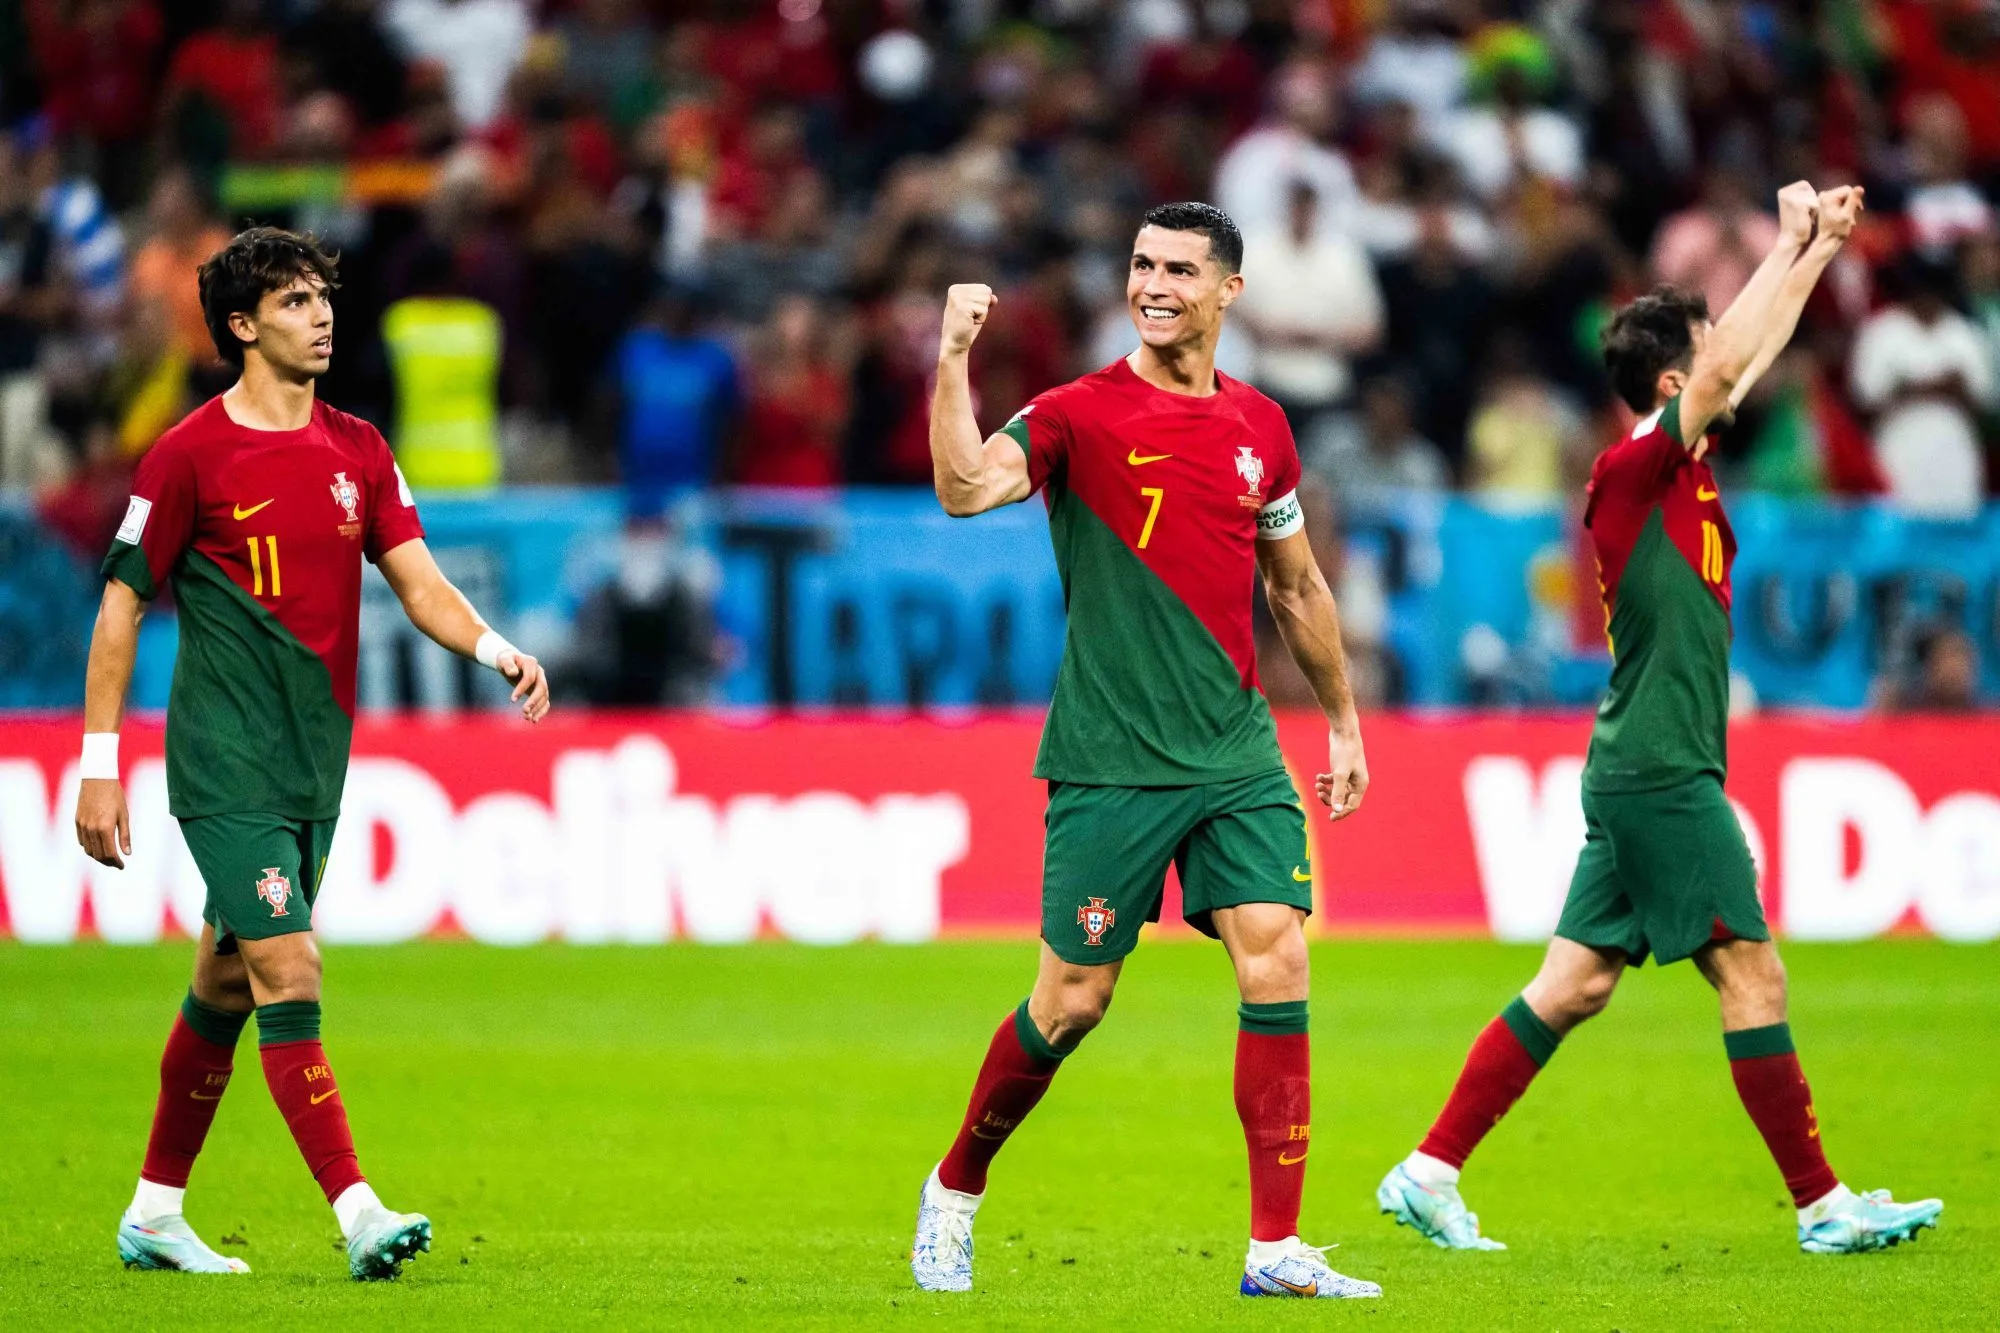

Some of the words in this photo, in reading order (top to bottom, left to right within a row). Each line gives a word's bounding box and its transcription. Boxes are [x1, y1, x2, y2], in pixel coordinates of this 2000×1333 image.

[1137, 487, 1164, 549] 7
[247, 535, 281, 596] 11
[1701, 519, 1724, 584] 10
